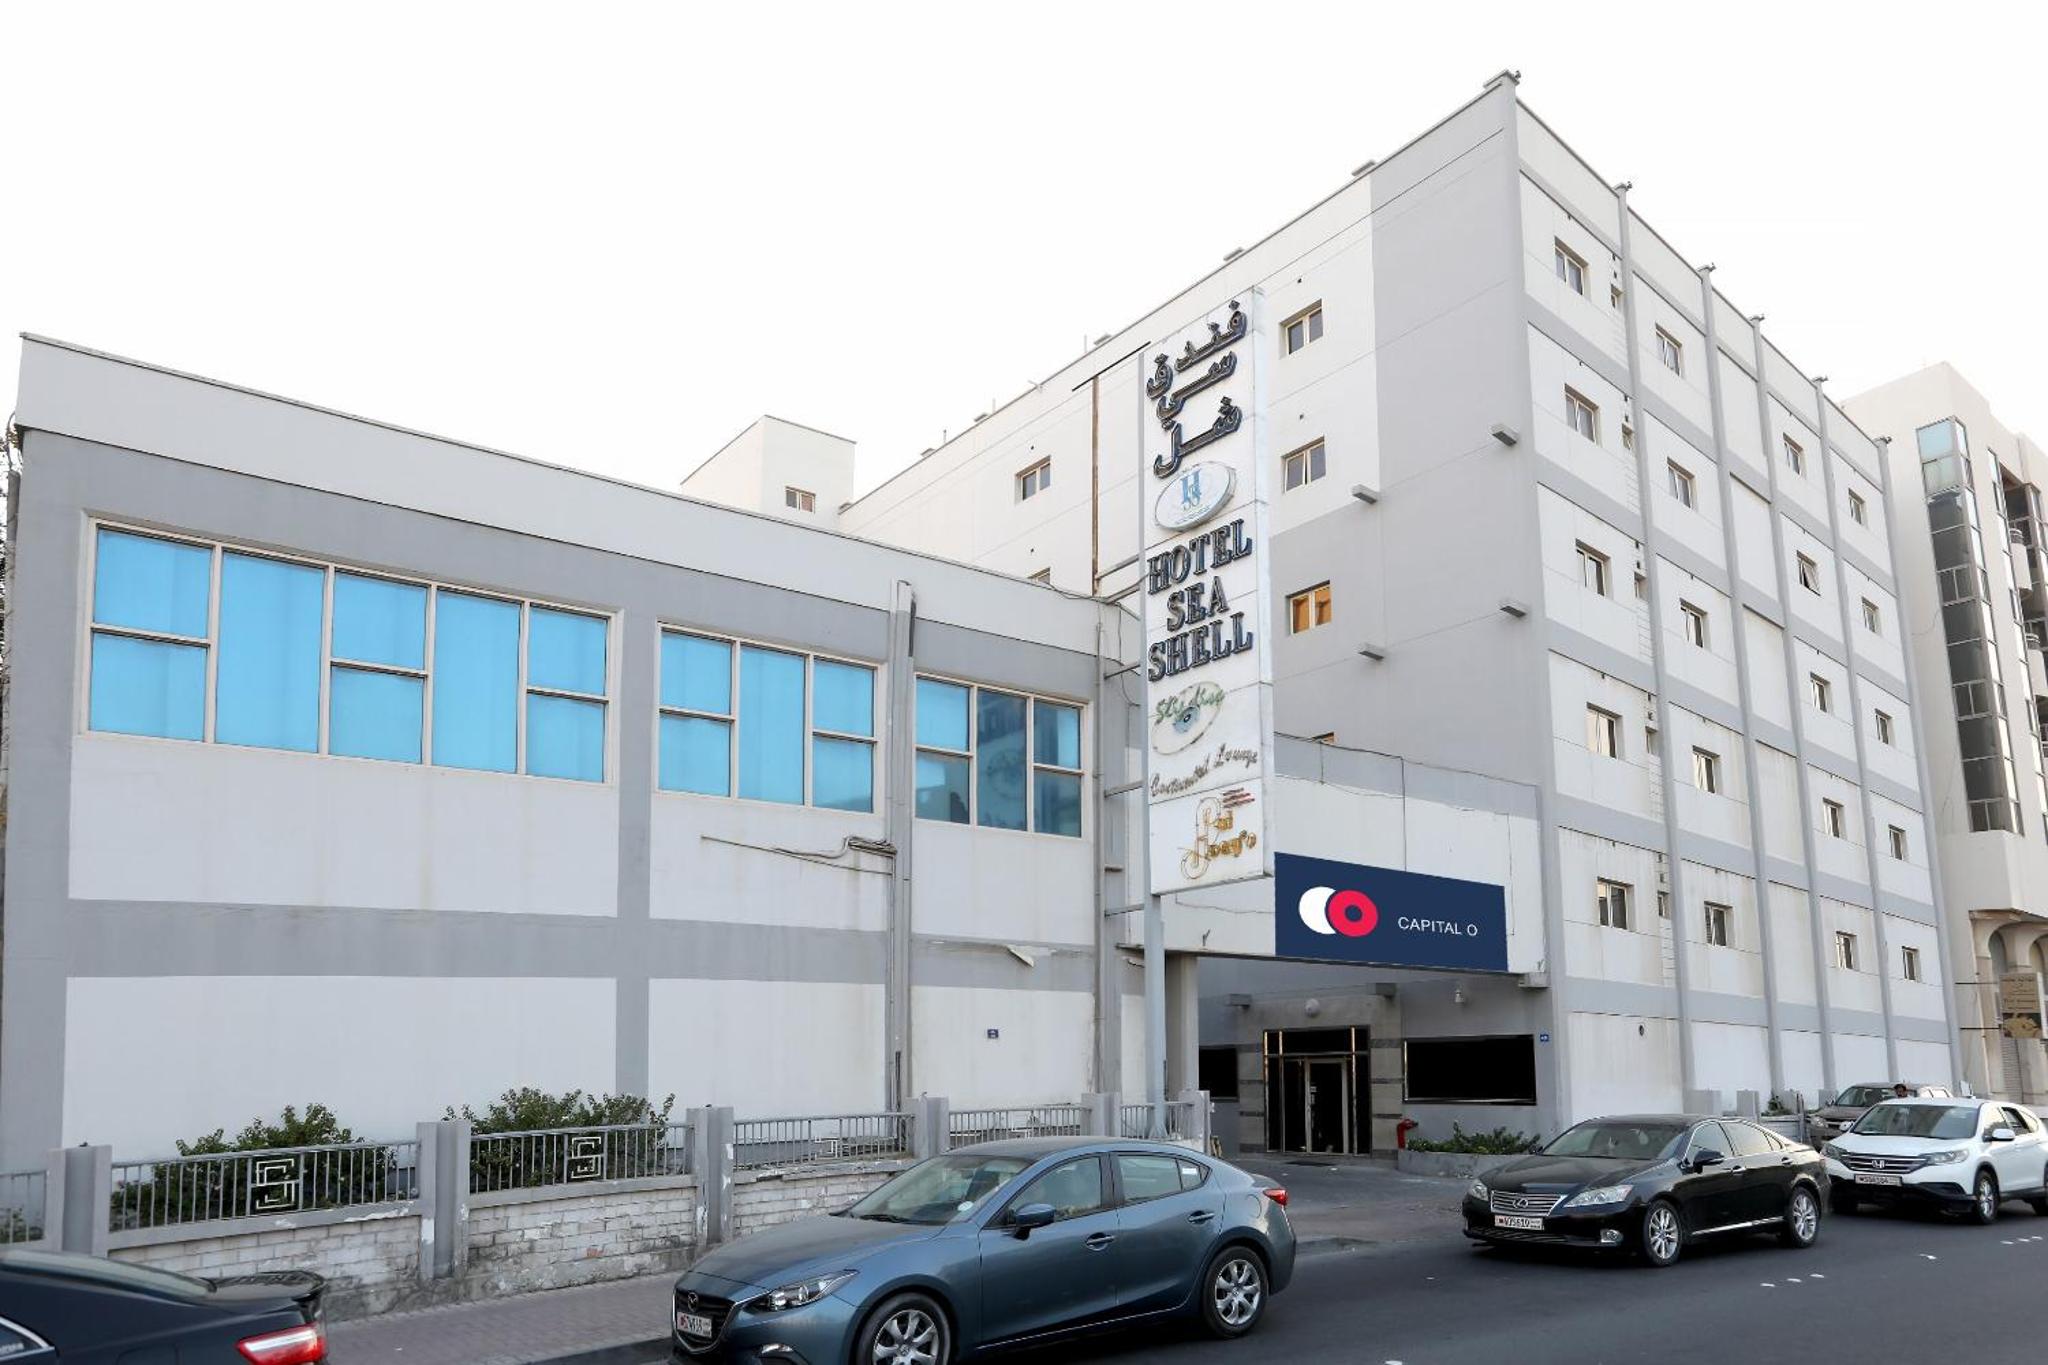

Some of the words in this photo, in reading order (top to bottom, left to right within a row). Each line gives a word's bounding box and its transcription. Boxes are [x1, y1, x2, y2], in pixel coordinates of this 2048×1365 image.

[1146, 300, 1247, 399] فندق
[1147, 518, 1253, 595] HOTEL
[1167, 575, 1230, 632] SEA
[1148, 611, 1254, 682] SHELL
[1397, 916, 1462, 936] CAPITAL
[1466, 923, 1478, 936] O
